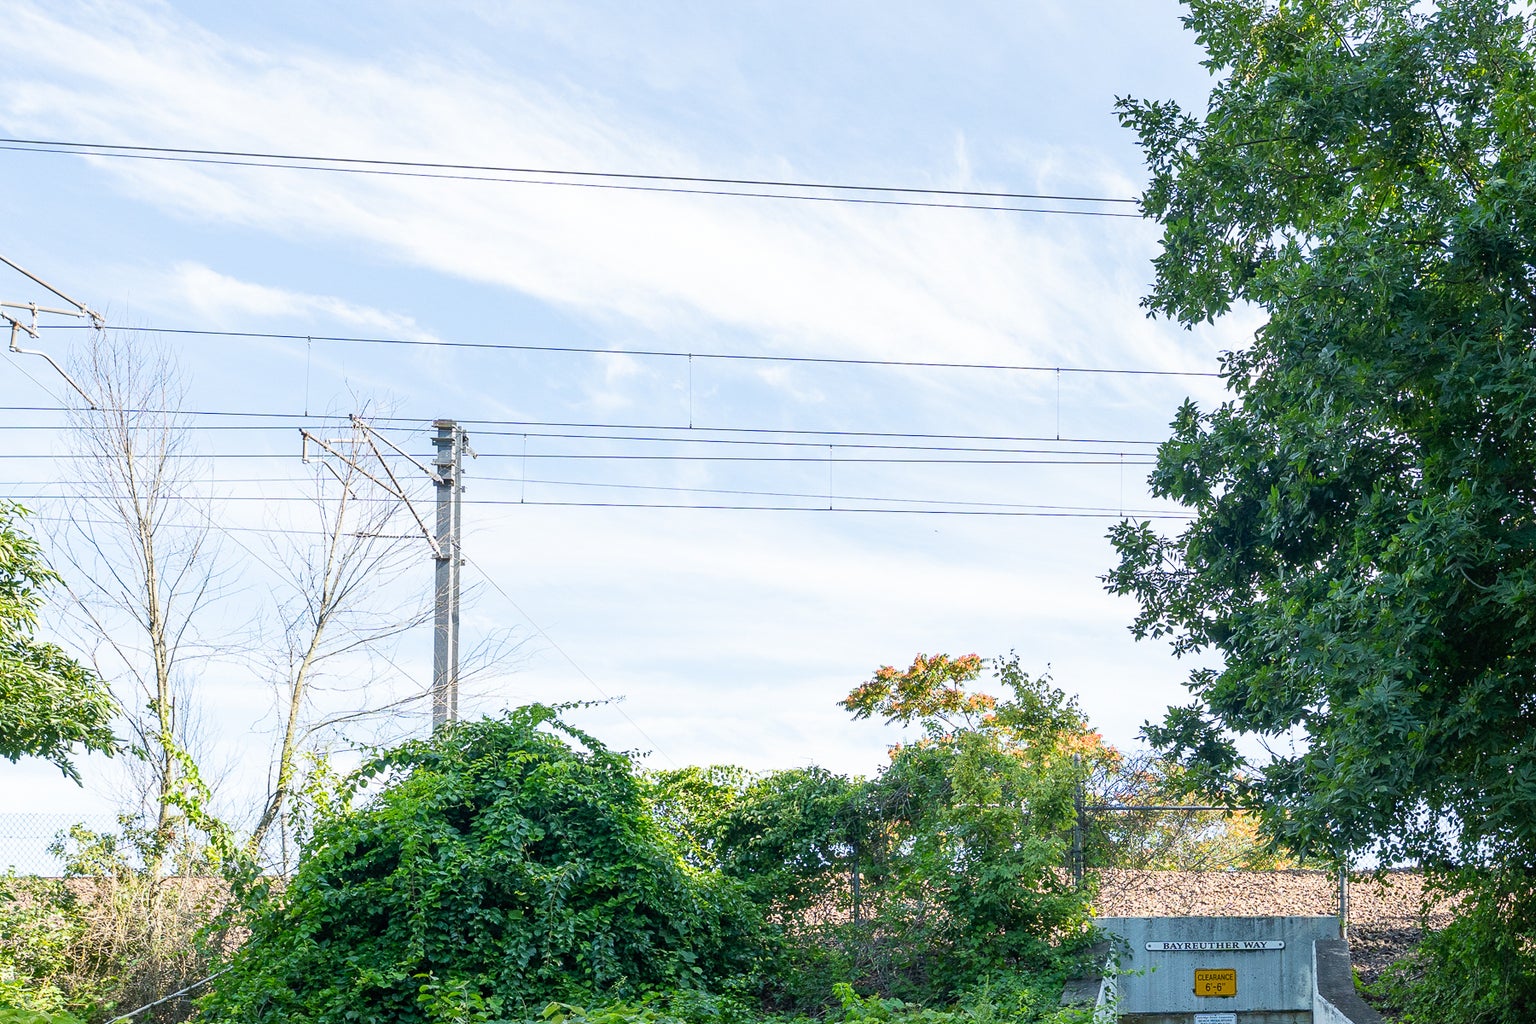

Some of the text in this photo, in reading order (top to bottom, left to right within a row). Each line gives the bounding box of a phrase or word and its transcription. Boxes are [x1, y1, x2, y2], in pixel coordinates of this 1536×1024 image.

[1163, 941, 1239, 950] BAYREUTHER
[1198, 973, 1233, 981] CLEARANCE
[1206, 982, 1226, 991] 6'-6"
